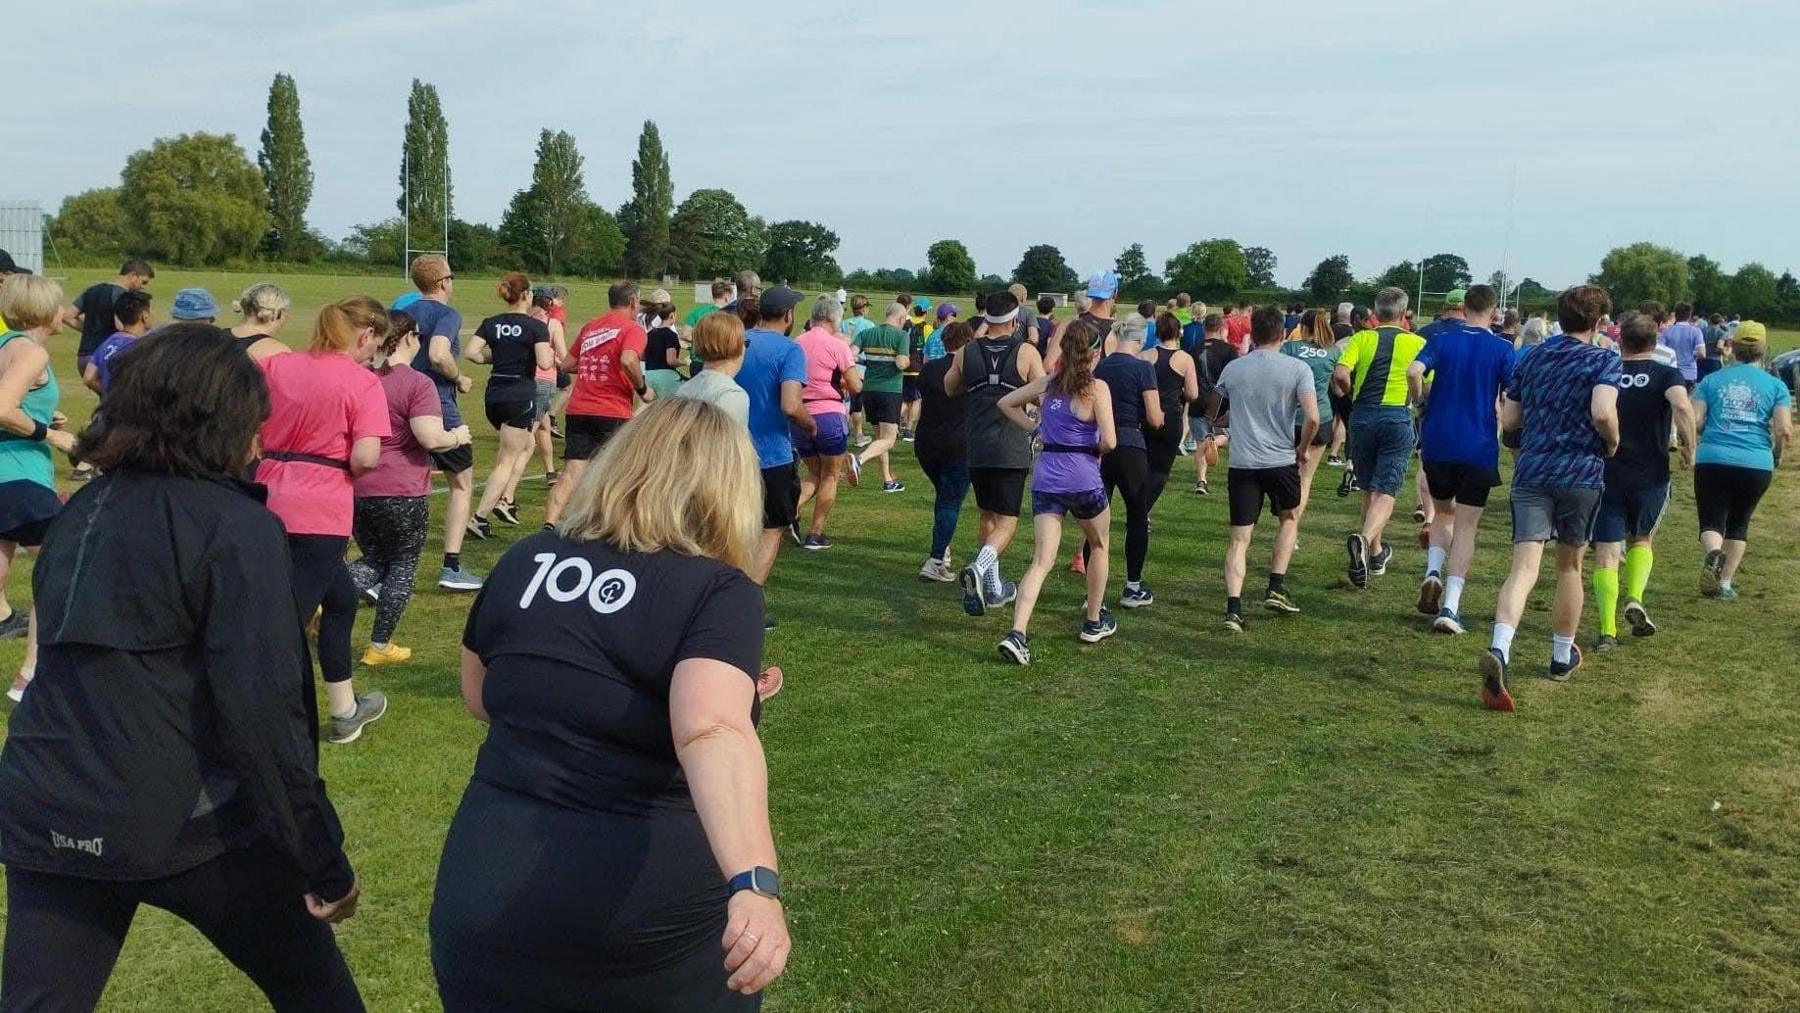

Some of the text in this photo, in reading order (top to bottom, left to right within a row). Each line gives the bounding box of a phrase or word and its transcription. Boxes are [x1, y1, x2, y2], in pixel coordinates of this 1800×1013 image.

[495, 323, 522, 339] 100
[1298, 345, 1328, 358] 250
[1620, 373, 1650, 388] 00
[1050, 398, 1063, 410] 25
[519, 552, 637, 614] 100
[50, 830, 103, 856] USA PRO
